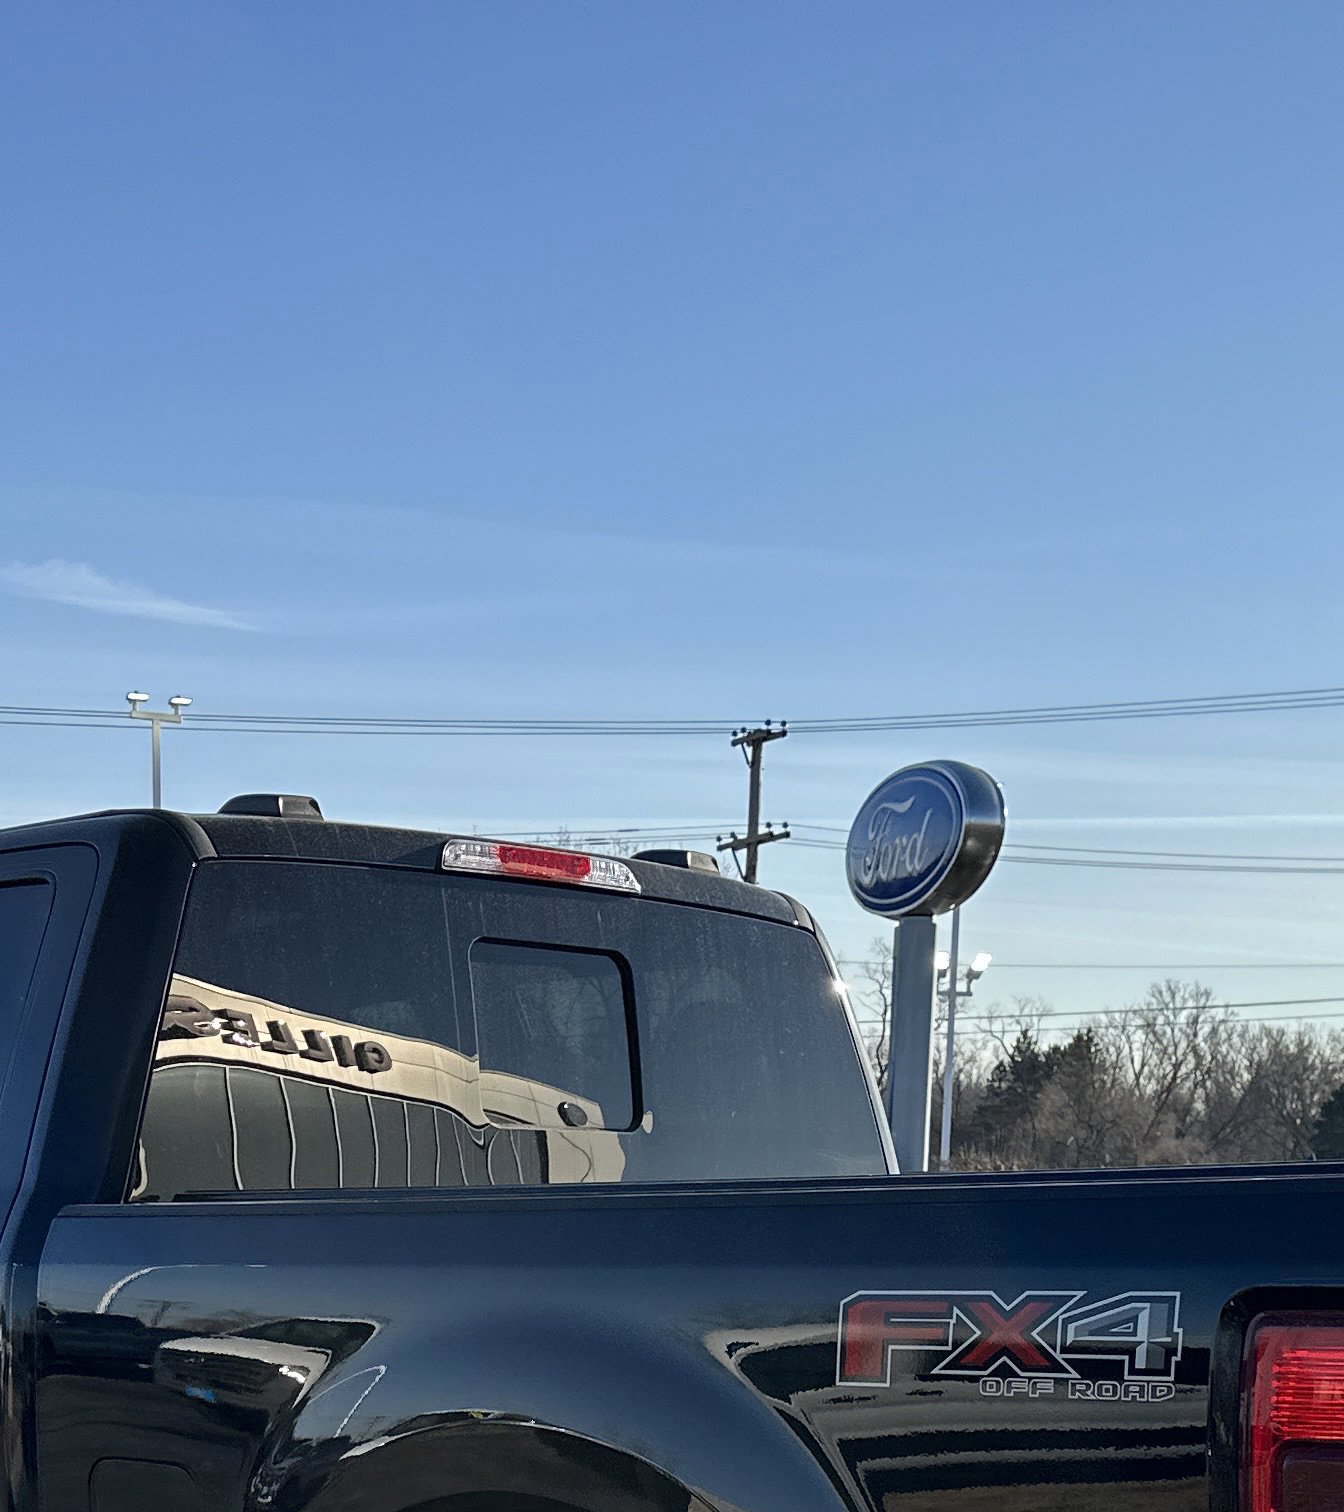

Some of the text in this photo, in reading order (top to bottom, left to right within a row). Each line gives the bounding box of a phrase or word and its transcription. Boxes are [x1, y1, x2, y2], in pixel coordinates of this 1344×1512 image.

[859, 796, 933, 888] Ford
[835, 1290, 1182, 1388] FX4
[979, 1377, 1175, 1401] OFF ROAD
